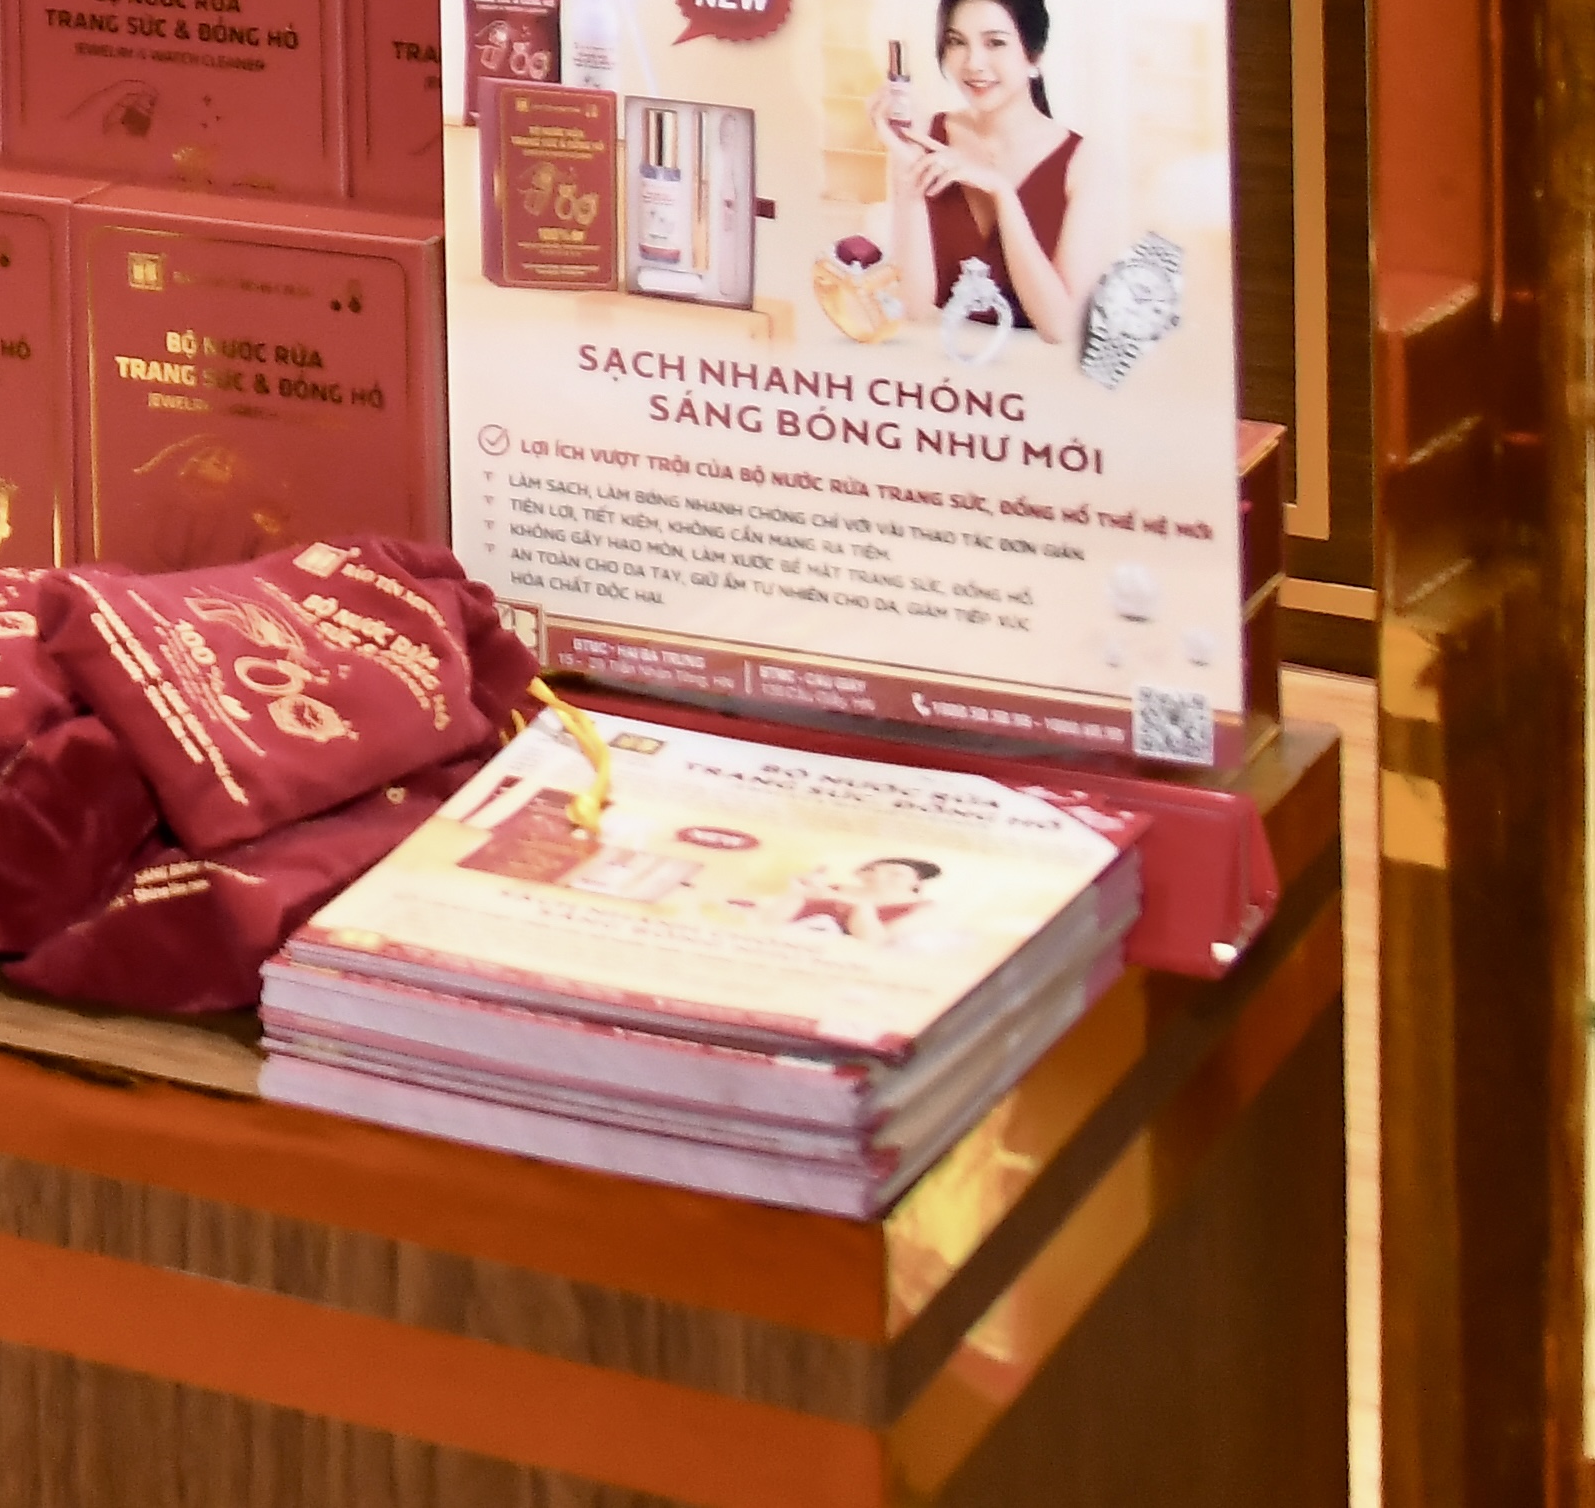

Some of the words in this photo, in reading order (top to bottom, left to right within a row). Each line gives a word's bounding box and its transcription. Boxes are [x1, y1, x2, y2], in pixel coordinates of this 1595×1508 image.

[45, 8, 120, 34] TRANG
[392, 40, 441, 64] TRA
[114, 355, 198, 387] TRANG
[578, 342, 686, 382] SẠCH
[698, 357, 855, 402] NHANH
[868, 376, 1026, 423] CHÓNG
[648, 389, 763, 434] SÁNG
[776, 405, 902, 450] BÓNG
[915, 426, 1010, 463] NHƯ
[1021, 436, 1104, 475] MỚI
[521, 438, 549, 459] LỢI
[554, 439, 585, 461] ÍCH
